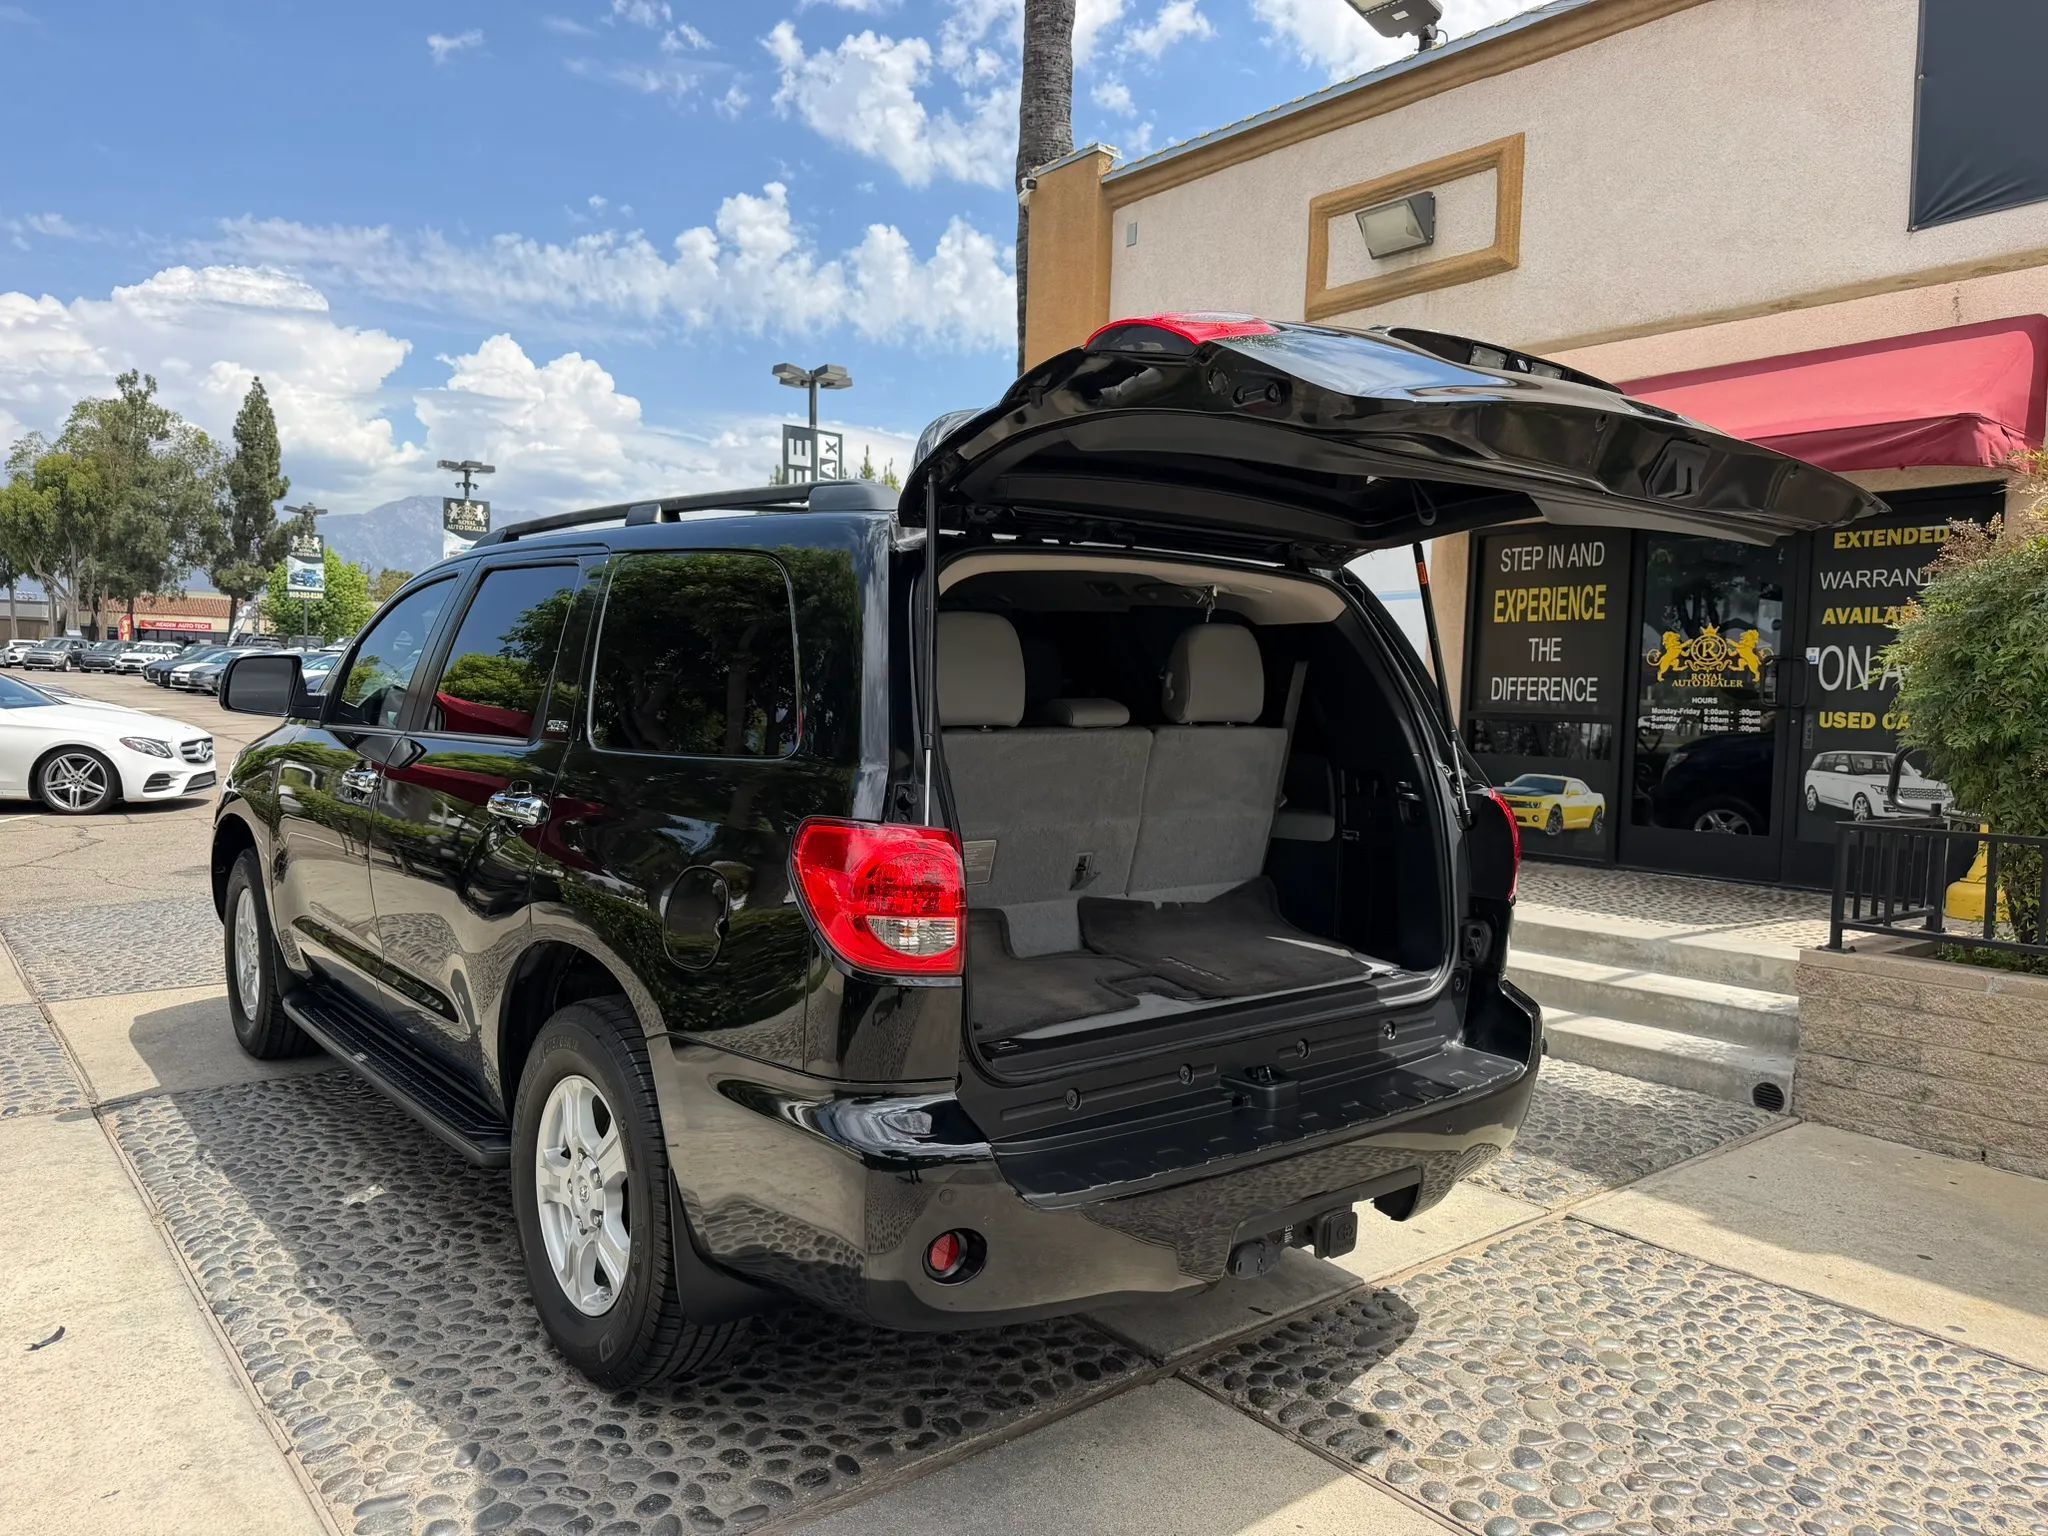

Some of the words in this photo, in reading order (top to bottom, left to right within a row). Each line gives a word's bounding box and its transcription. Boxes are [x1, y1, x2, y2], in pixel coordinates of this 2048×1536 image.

[1834, 527, 1950, 549] EXTENDED
[1500, 546, 1543, 572] STEP
[1548, 544, 1564, 569] IN
[1567, 541, 1605, 568] AND
[1493, 584, 1607, 623] EXPERIENCE
[1529, 637, 1562, 662] THE
[1702, 640, 1718, 658] R
[1818, 645, 1871, 691] ON
[1491, 676, 1598, 702] DIFFERENCE
[1650, 714, 1681, 723] Saturday
[1651, 707, 1700, 716] Monday-Friday
[1819, 711, 1876, 729] USED
[1650, 722, 1677, 731] Sunday
